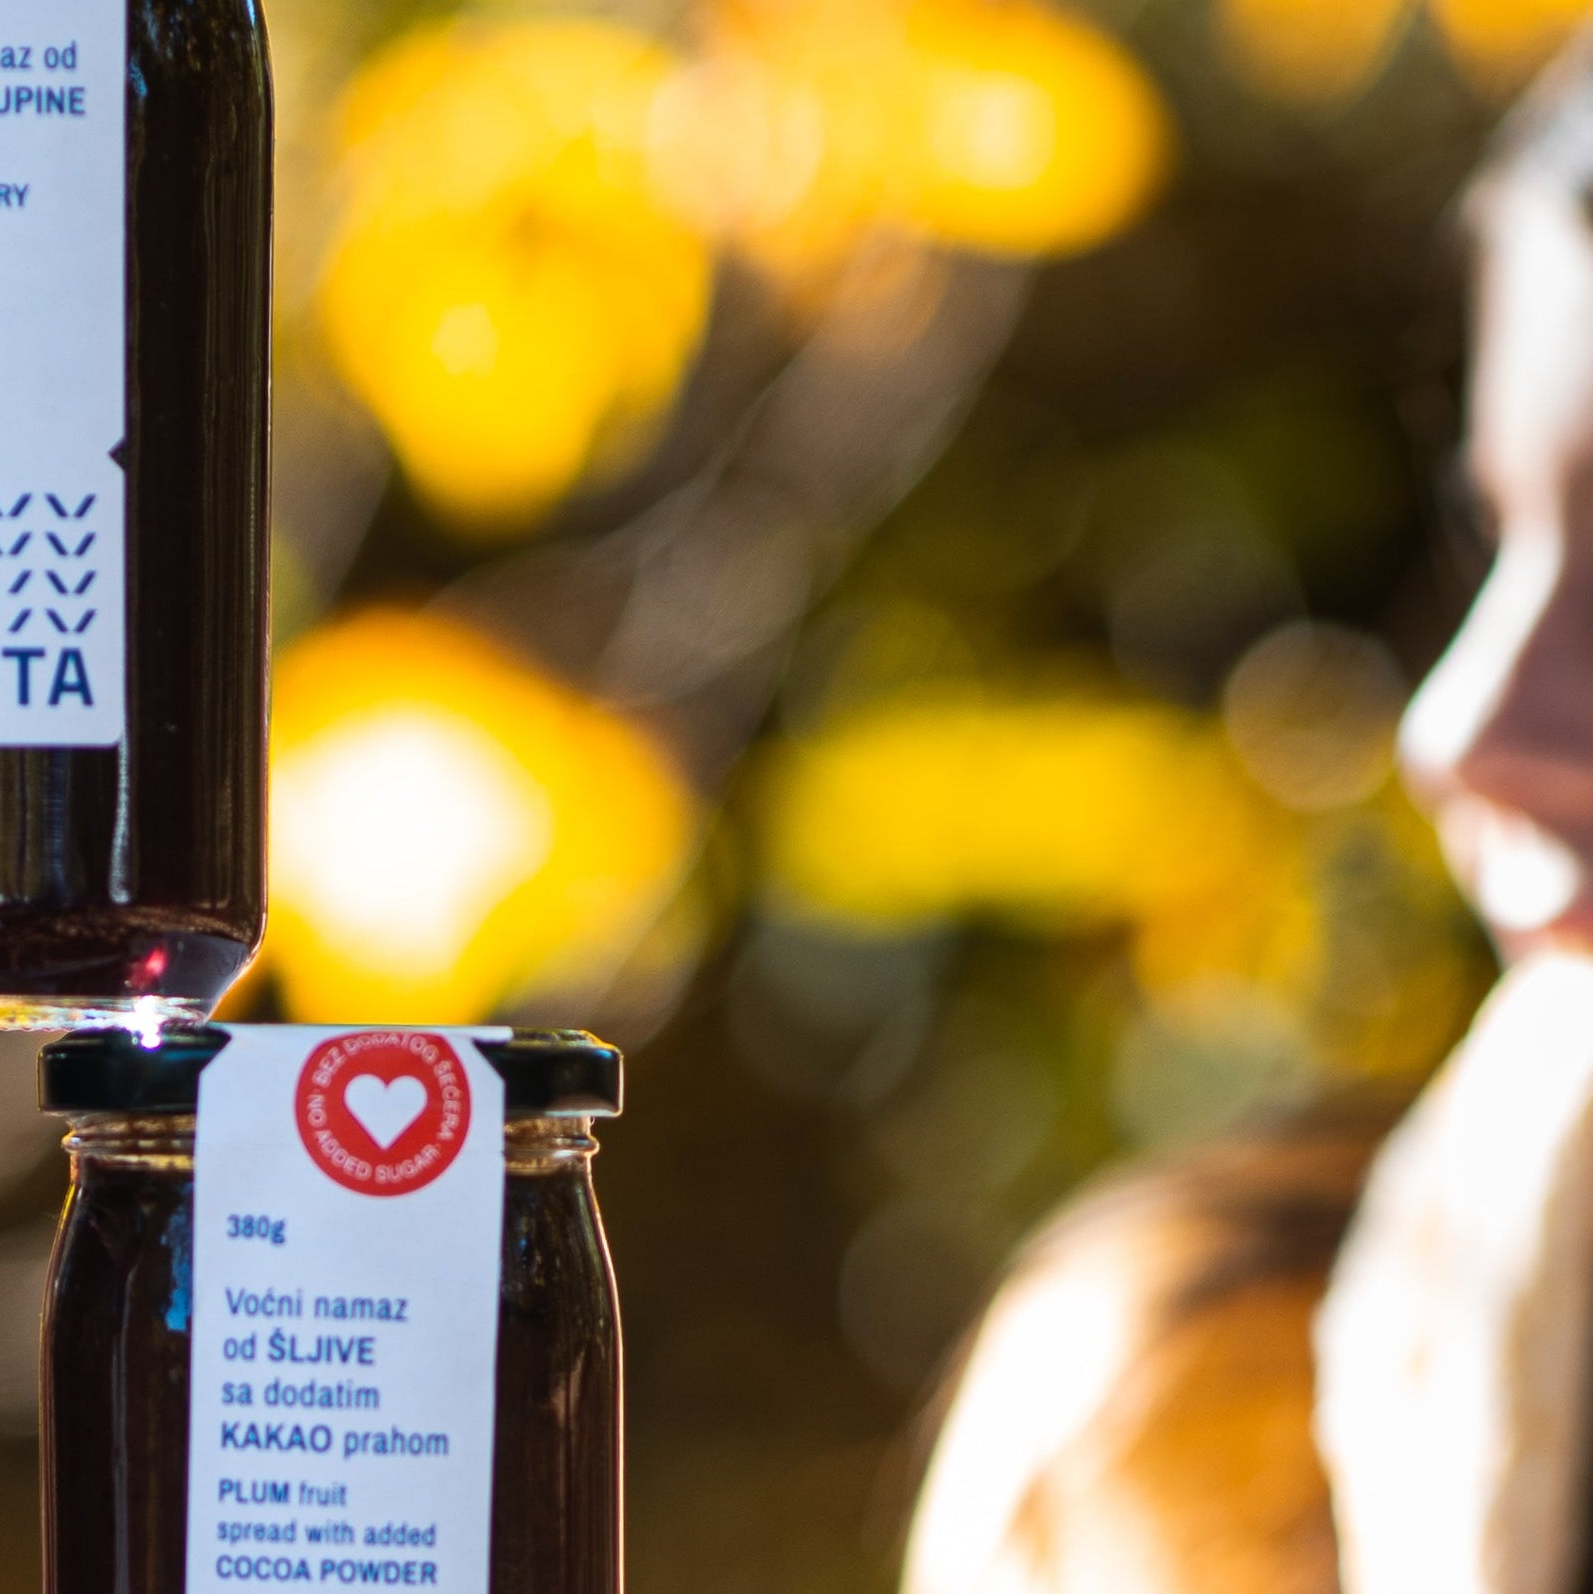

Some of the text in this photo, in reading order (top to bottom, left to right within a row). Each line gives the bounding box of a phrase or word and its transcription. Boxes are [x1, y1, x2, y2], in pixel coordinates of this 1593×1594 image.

[44, 41, 77, 72] od
[308, 1094, 326, 1127] NO
[228, 1215, 285, 1245] 380g
[225, 1288, 407, 1322] Voćni namaz
[223, 1328, 374, 1366] od ŠLJIVE
[223, 1379, 380, 1409] sa dodatim
[221, 1422, 449, 1458] KAKAO prahom
[219, 1479, 347, 1507] PLUM fruit
[217, 1521, 436, 1548] spread with added
[216, 1555, 437, 1585] COCOA POWDER
